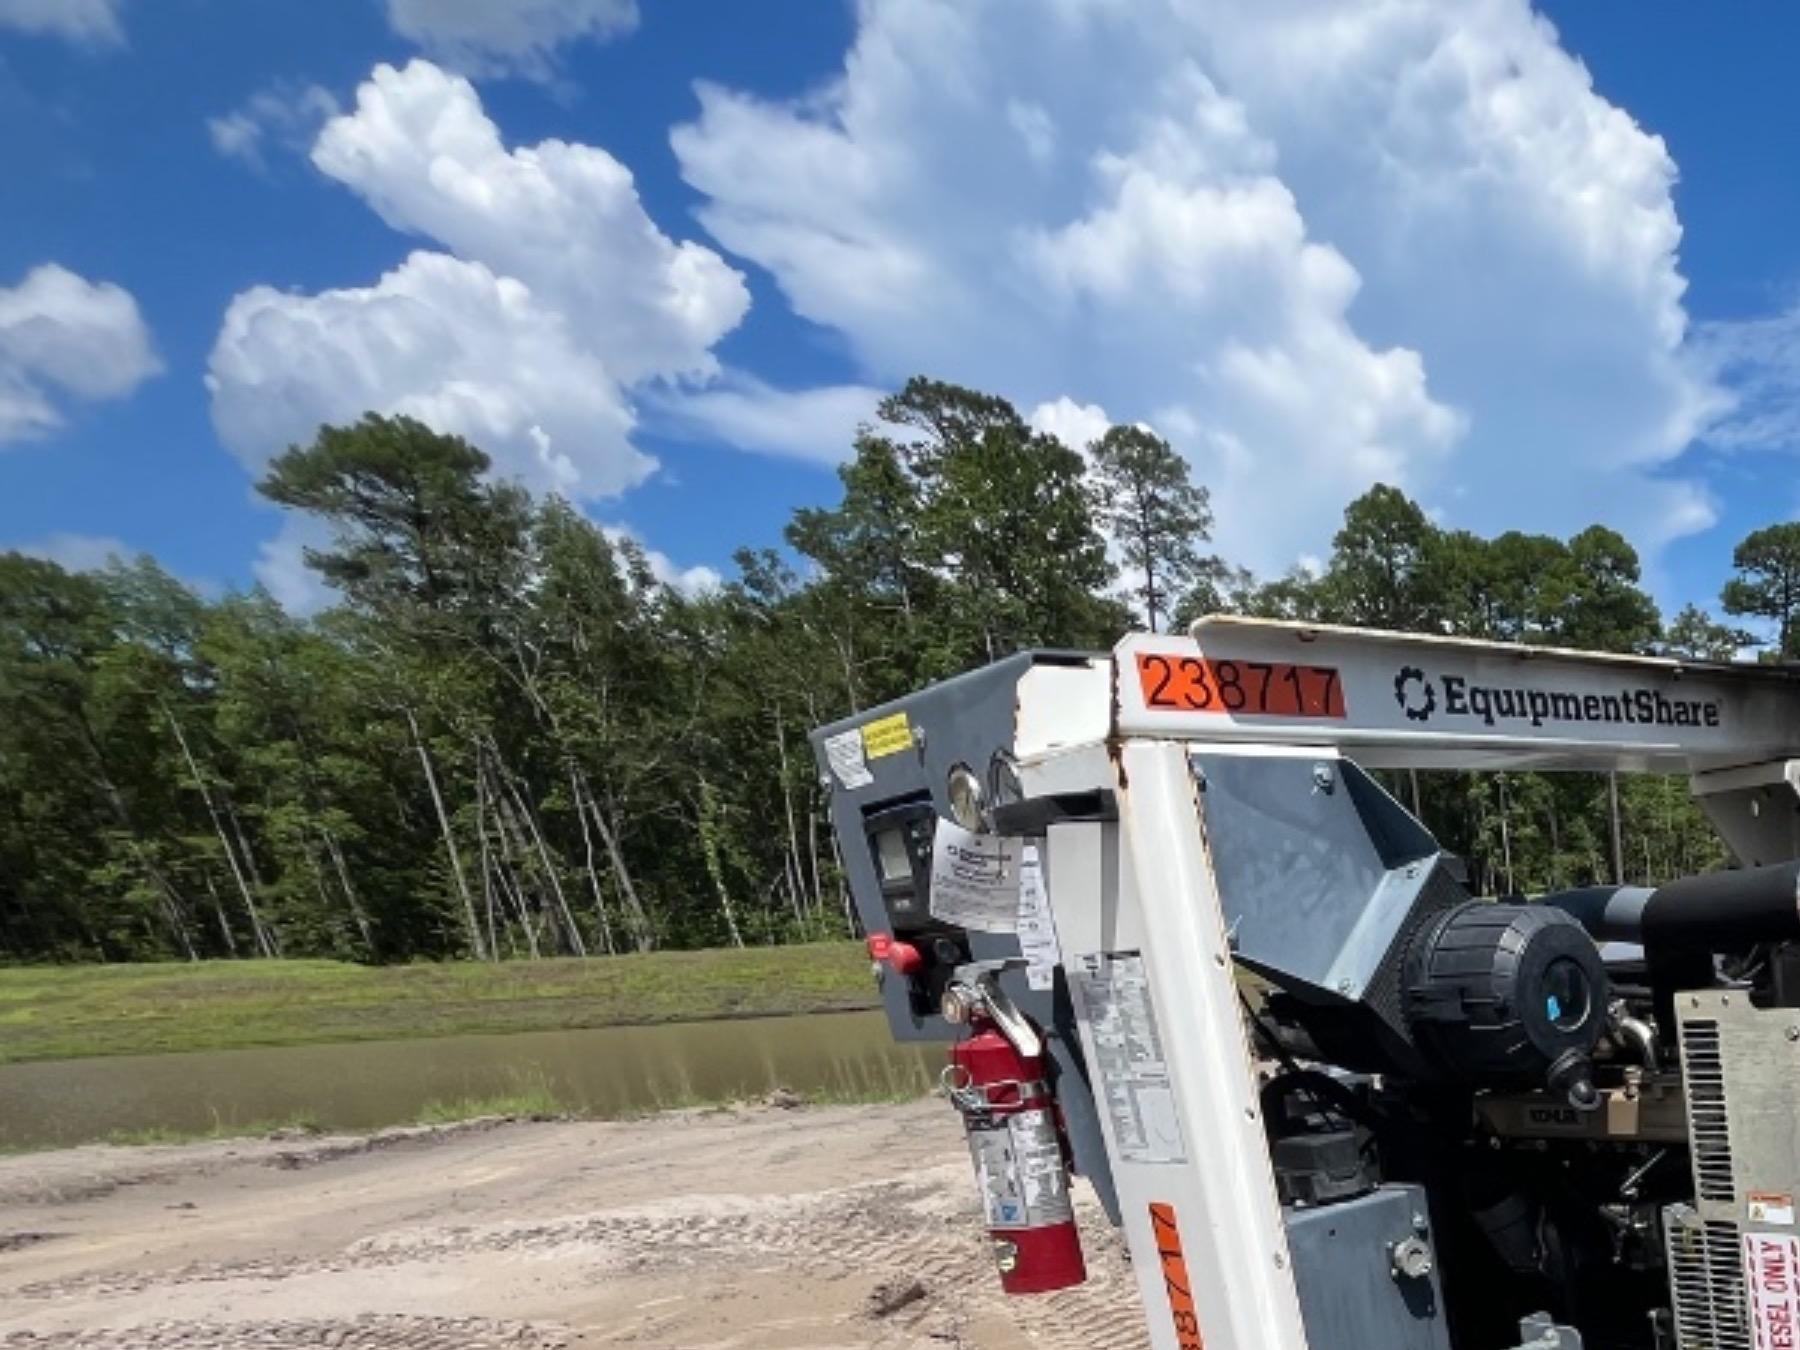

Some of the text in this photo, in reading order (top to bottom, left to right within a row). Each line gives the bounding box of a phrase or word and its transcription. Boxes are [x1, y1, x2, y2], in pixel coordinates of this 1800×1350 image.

[1143, 654, 1338, 715] 238717
[1445, 673, 1720, 729] EquipmentShare
[1760, 1241, 1788, 1293] ONLY
